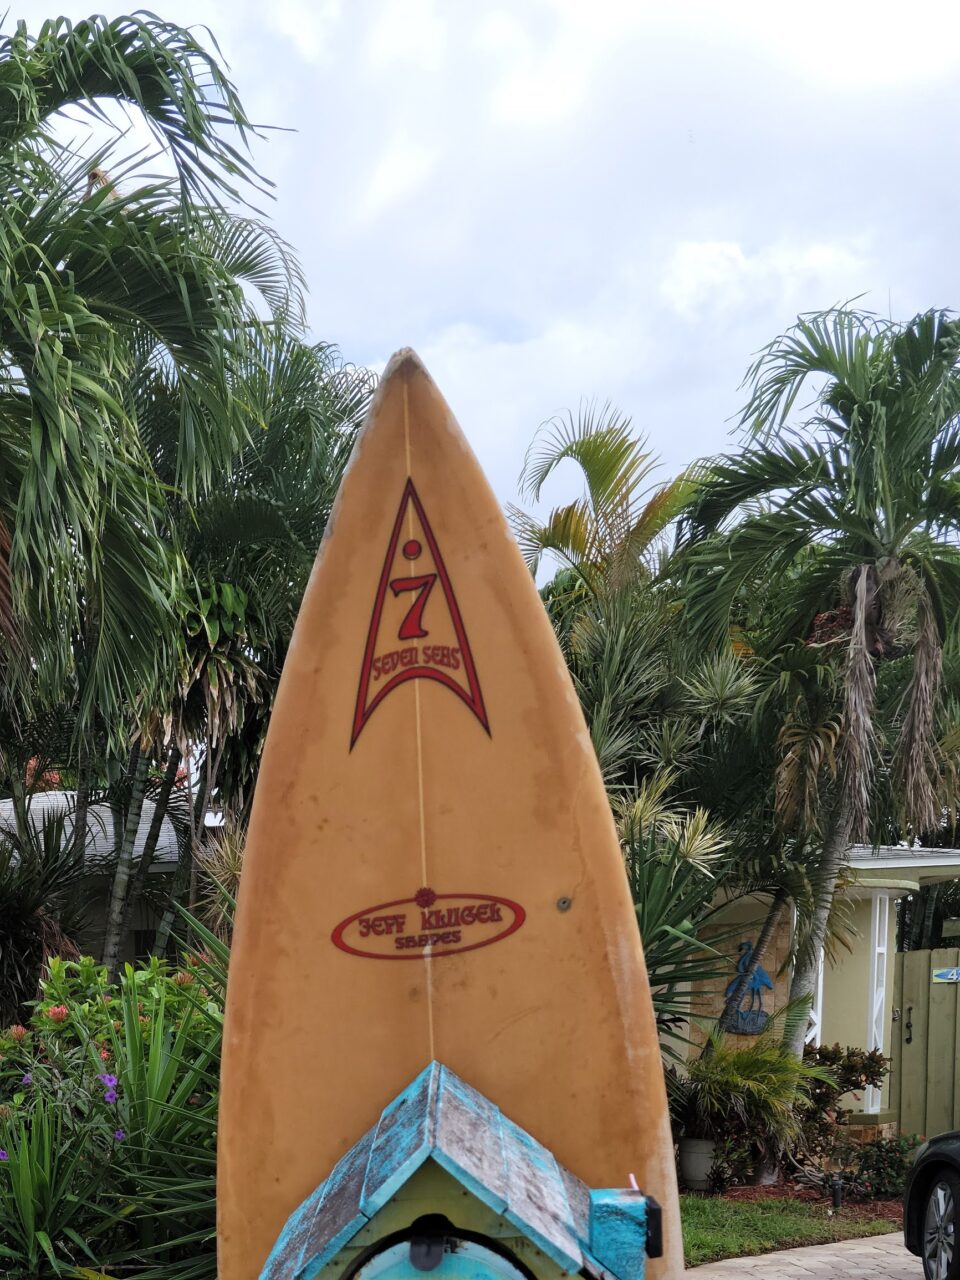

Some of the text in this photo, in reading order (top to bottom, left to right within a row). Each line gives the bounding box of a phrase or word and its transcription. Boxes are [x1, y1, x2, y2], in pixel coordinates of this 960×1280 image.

[390, 573, 438, 641] 7
[373, 645, 461, 681] SEVEN SEAS
[358, 914, 407, 938] JEFF
